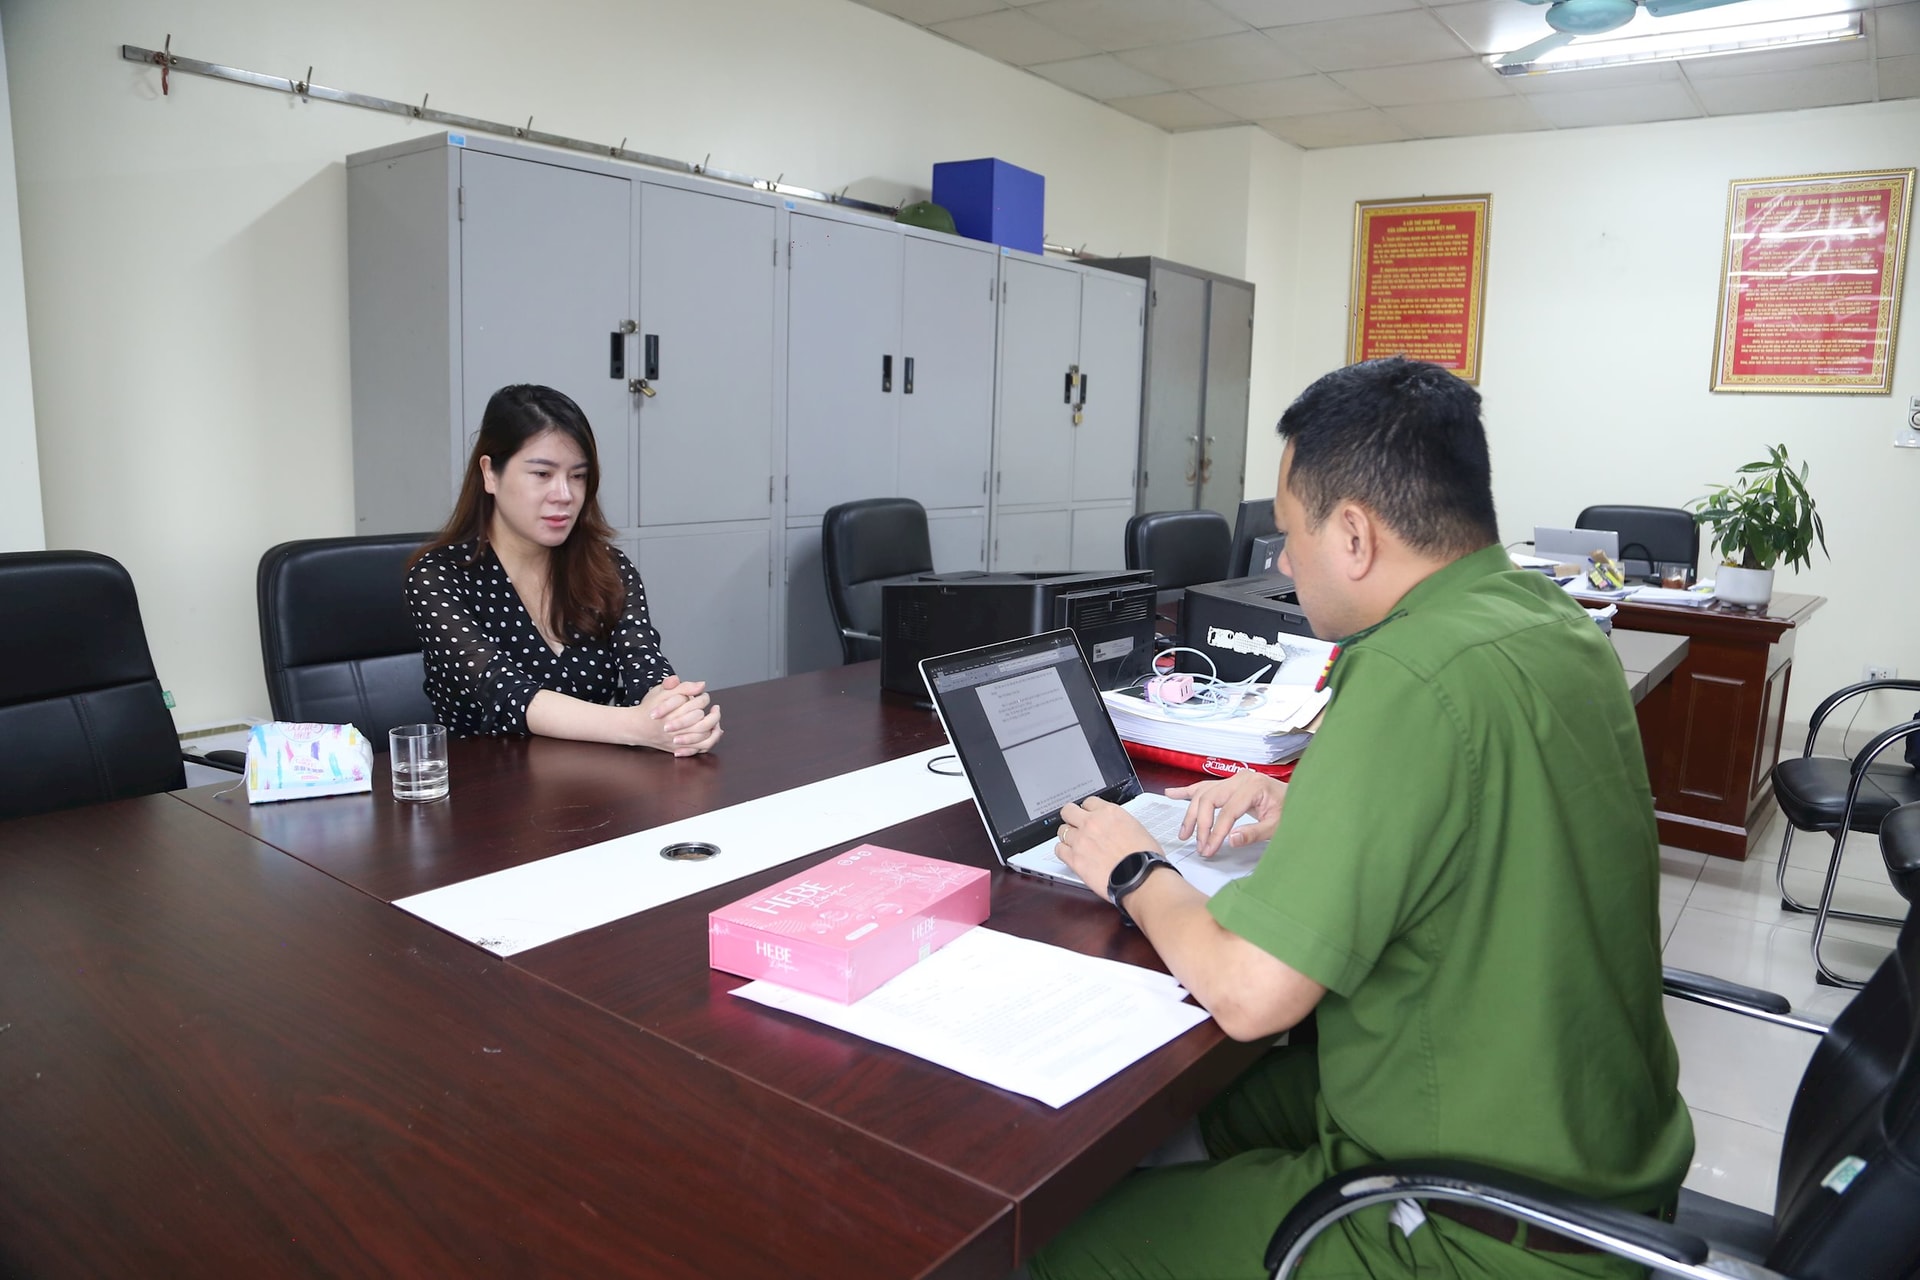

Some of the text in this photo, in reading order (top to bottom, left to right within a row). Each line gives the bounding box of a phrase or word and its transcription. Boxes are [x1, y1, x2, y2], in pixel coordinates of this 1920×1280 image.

[1204, 760, 1246, 774] upreme
[752, 880, 832, 915] HEBE
[756, 940, 792, 964] HEBE
